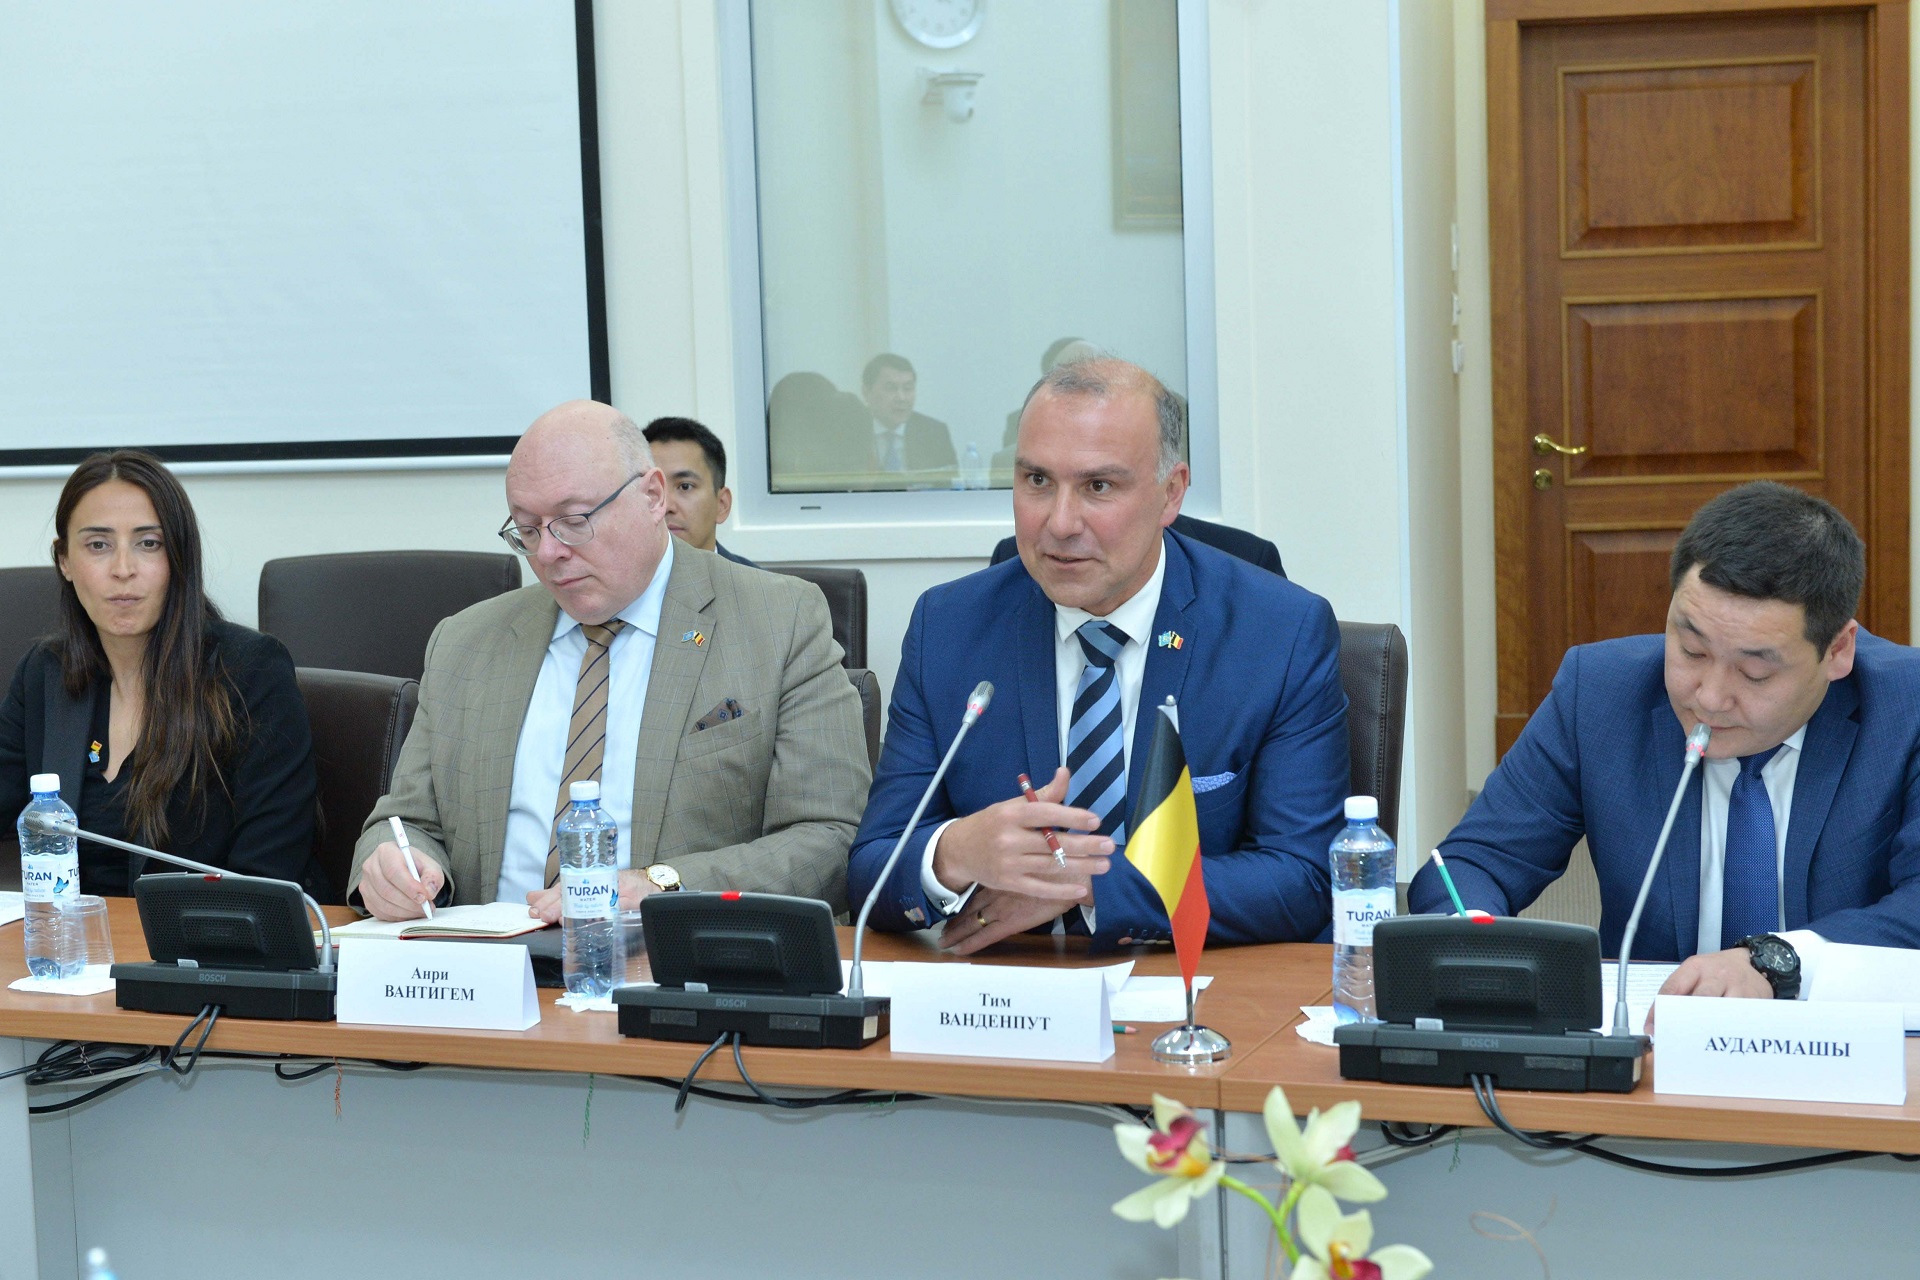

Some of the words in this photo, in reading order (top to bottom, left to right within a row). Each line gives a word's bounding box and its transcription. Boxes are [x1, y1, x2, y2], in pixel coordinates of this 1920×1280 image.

[21, 870, 52, 881] URAN
[567, 884, 609, 896] TURAN
[1346, 909, 1391, 922] TURAN
[199, 973, 227, 983] BOSCH
[411, 966, 449, 984] Анри
[384, 984, 475, 1001] ВАНТИГЕМ
[715, 998, 747, 1008] BOSCH
[979, 992, 1012, 1008] Тим
[939, 1011, 1051, 1031] ВАНДЕНПУТ
[1461, 1037, 1499, 1049] BOSCH
[1704, 1036, 1851, 1058] АУДАРМАШЫ
